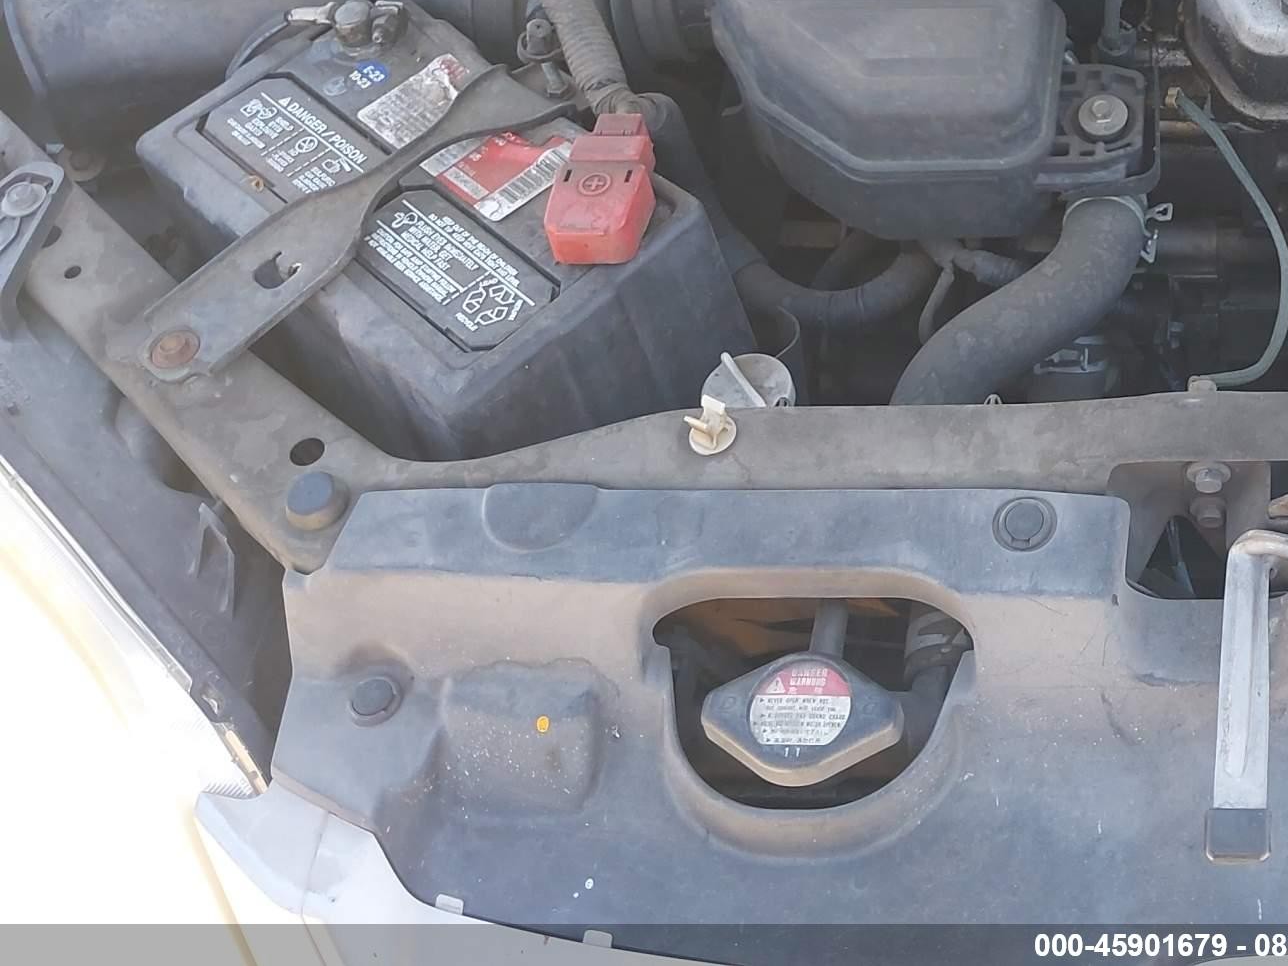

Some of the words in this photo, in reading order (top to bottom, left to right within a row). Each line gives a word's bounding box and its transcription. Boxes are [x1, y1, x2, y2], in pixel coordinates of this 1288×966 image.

[286, 102, 327, 133] DANGER
[328, 134, 367, 163] POISON
[790, 677, 826, 687] WARNING
